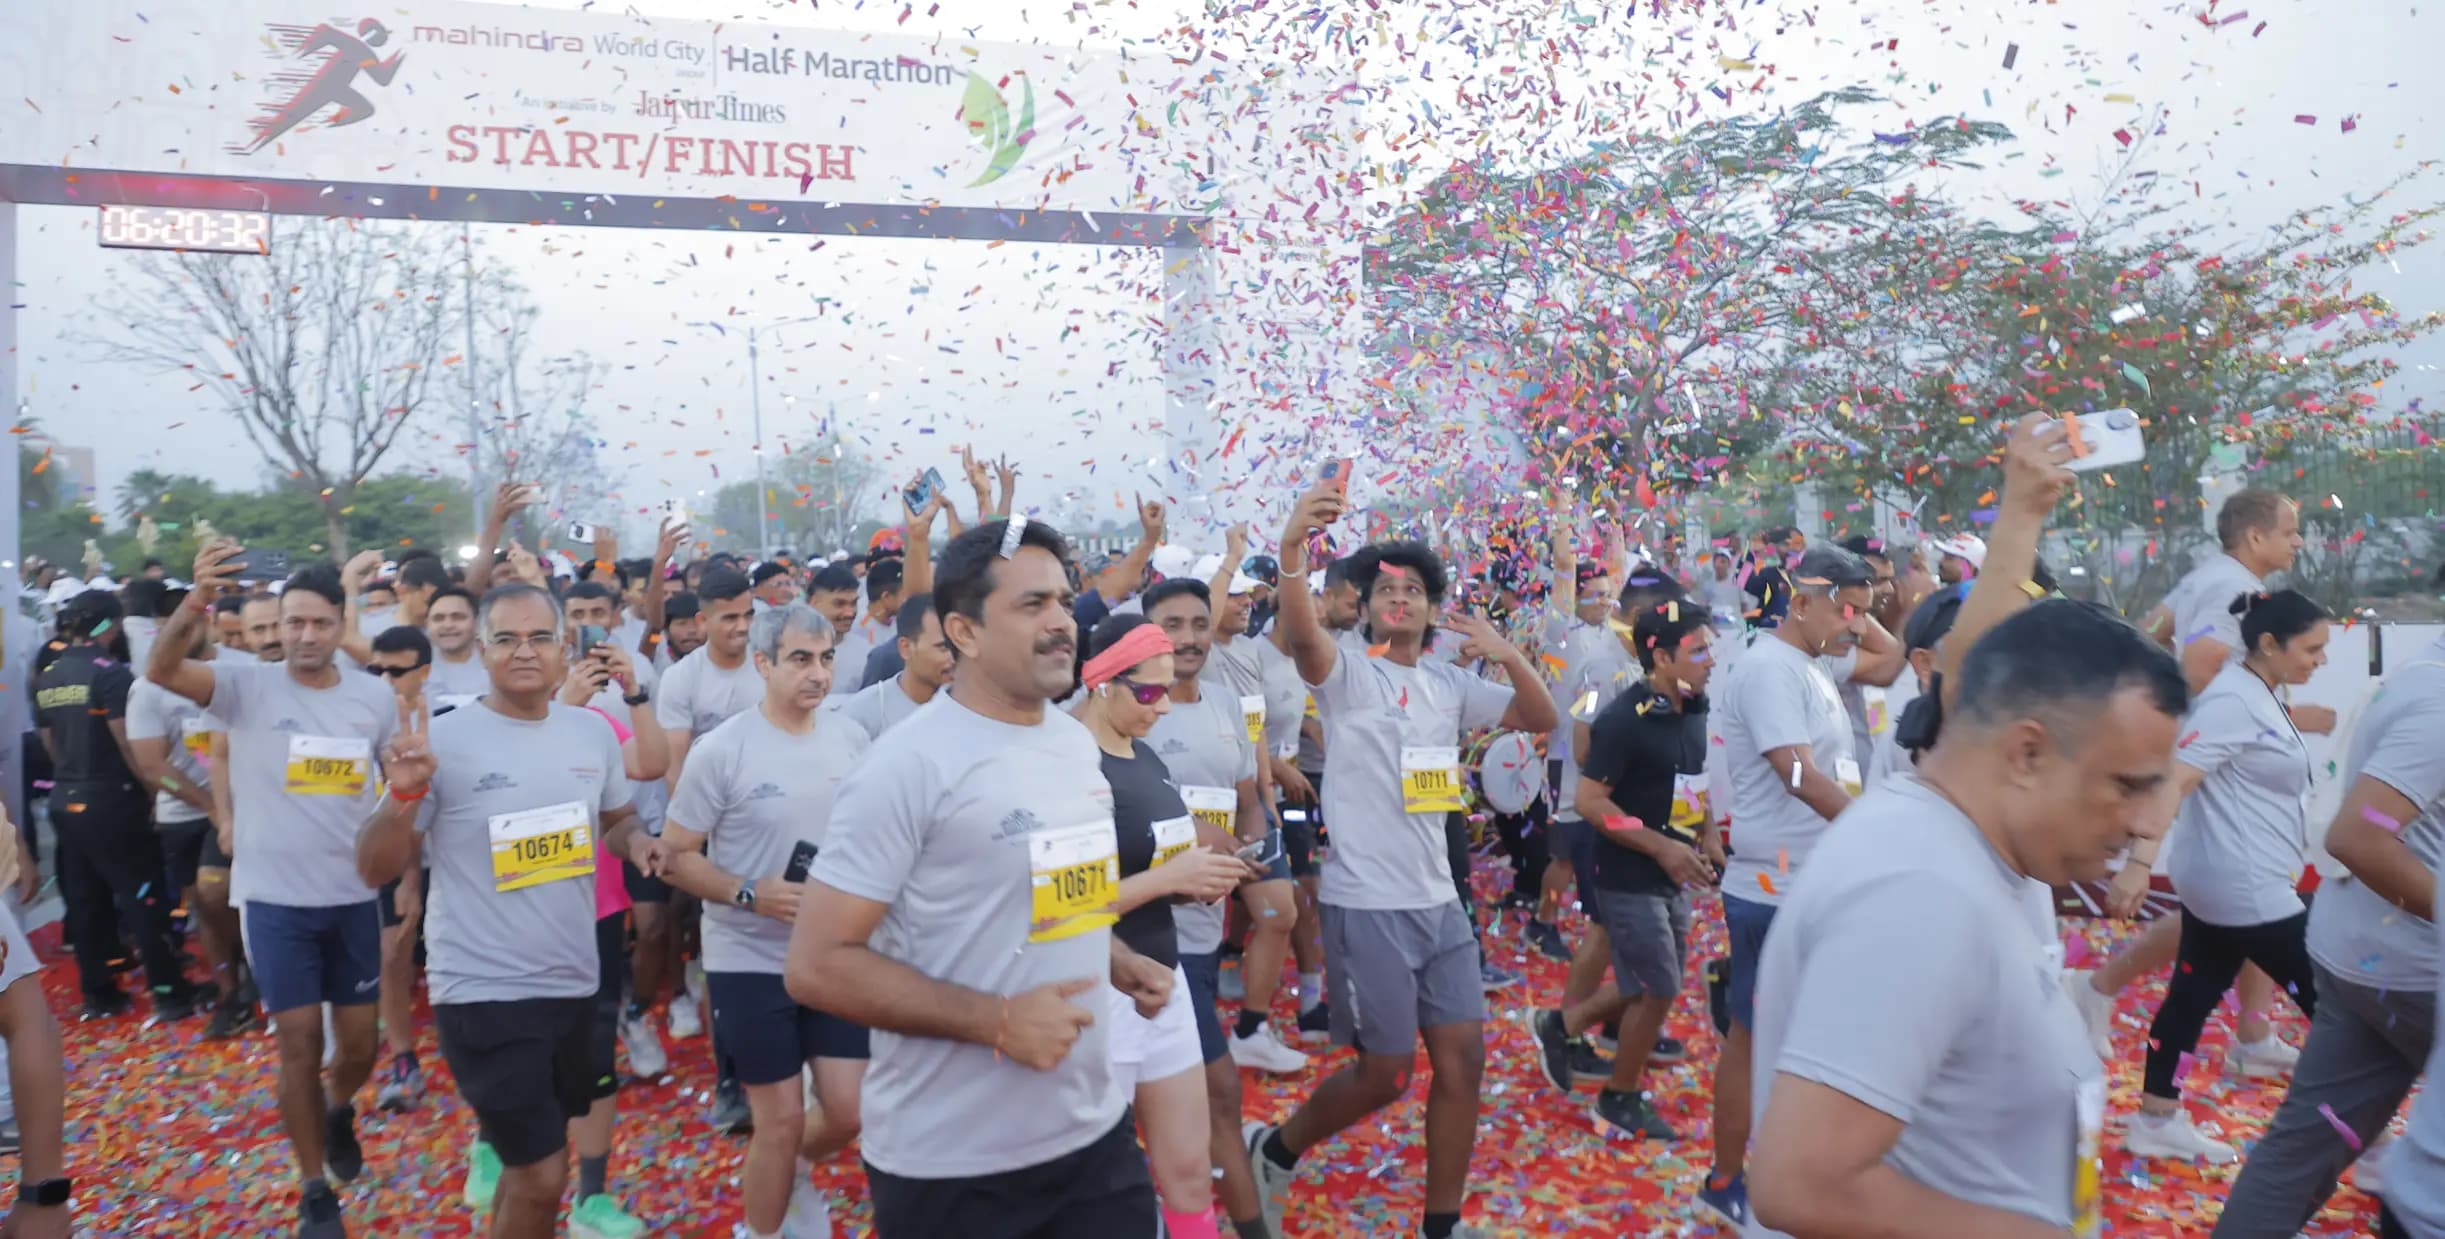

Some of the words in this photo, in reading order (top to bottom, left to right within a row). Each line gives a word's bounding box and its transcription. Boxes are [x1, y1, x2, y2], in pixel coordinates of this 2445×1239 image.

[413, 25, 585, 53] mahindra
[594, 34, 658, 59] World
[664, 39, 706, 66] City
[726, 44, 794, 75] Half
[804, 50, 951, 85] Marathon
[716, 94, 787, 124] Times
[447, 124, 856, 181] START/FINISH
[103, 207, 268, 247] 06:20:32
[303, 759, 354, 777] 10672
[1413, 770, 1448, 790] 10711
[513, 832, 574, 862] 10674
[1053, 861, 1107, 903] 10671
